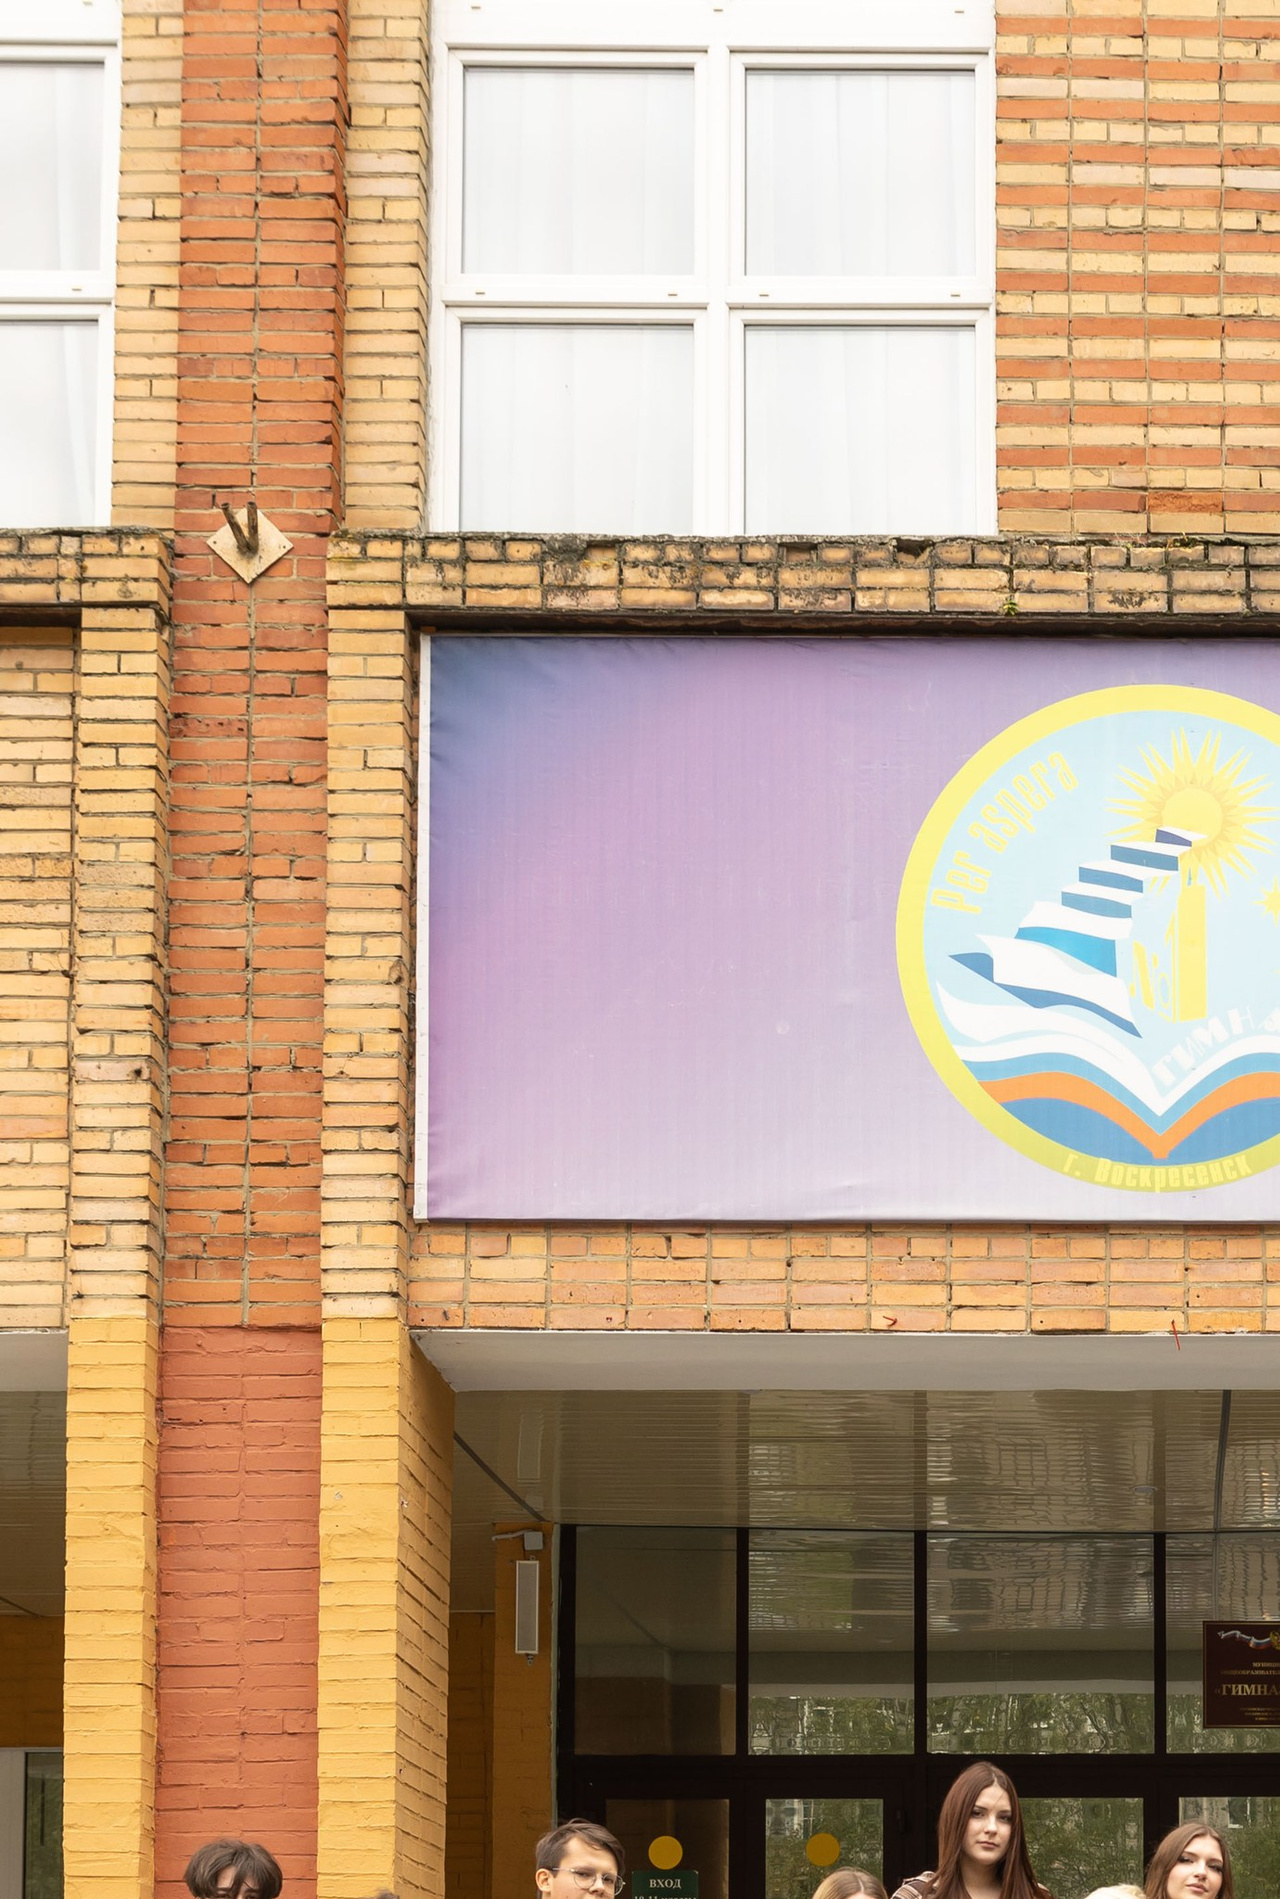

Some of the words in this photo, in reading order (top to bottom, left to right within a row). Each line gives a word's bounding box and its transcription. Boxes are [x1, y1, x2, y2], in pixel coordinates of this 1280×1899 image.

[931, 850, 993, 915] Per
[968, 751, 1079, 854] aspera
[1094, 1154, 1253, 1193] Воскресенск
[649, 1878, 682, 1890] ВХОД
